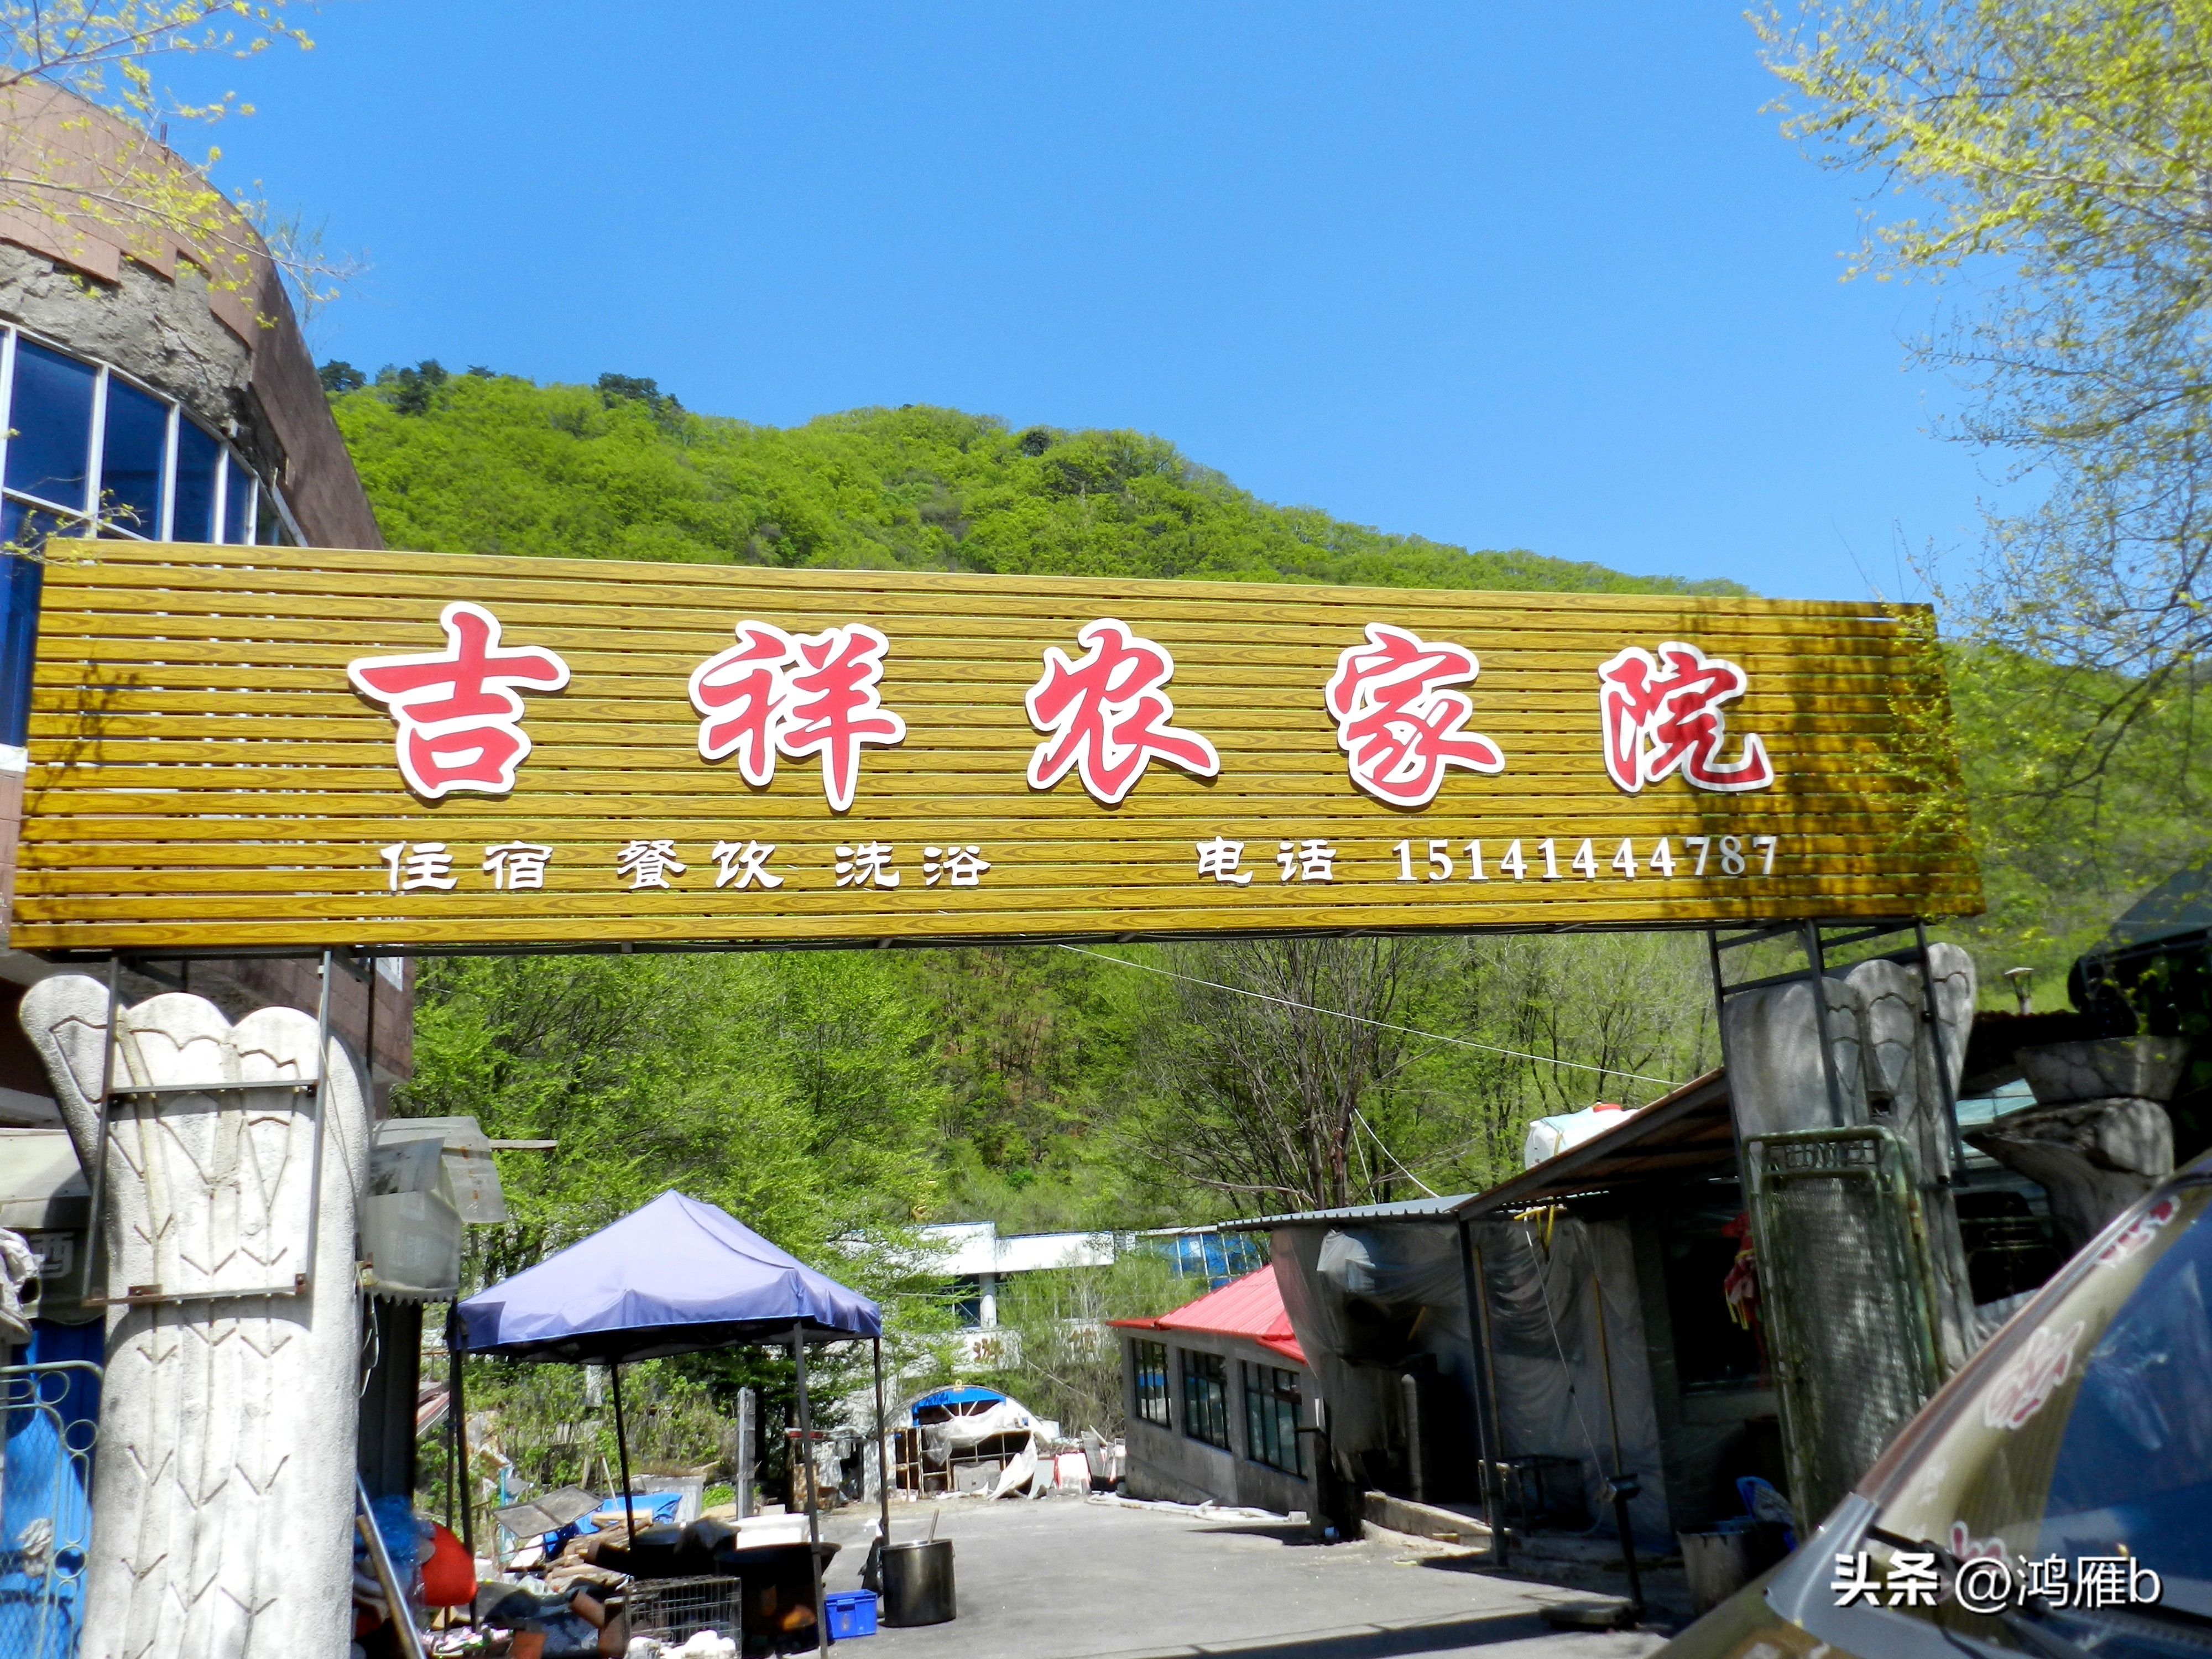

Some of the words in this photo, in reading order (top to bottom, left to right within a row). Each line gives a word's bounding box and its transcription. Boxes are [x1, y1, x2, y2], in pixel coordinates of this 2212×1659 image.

[346, 601, 1775, 811] 吉祥农家院
[380, 840, 553, 891] 住宿
[617, 839, 784, 889] 餐饮
[834, 841, 992, 888] 洗浴
[1196, 836, 1337, 884] 电话
[1392, 835, 1777, 880] 15141444787
